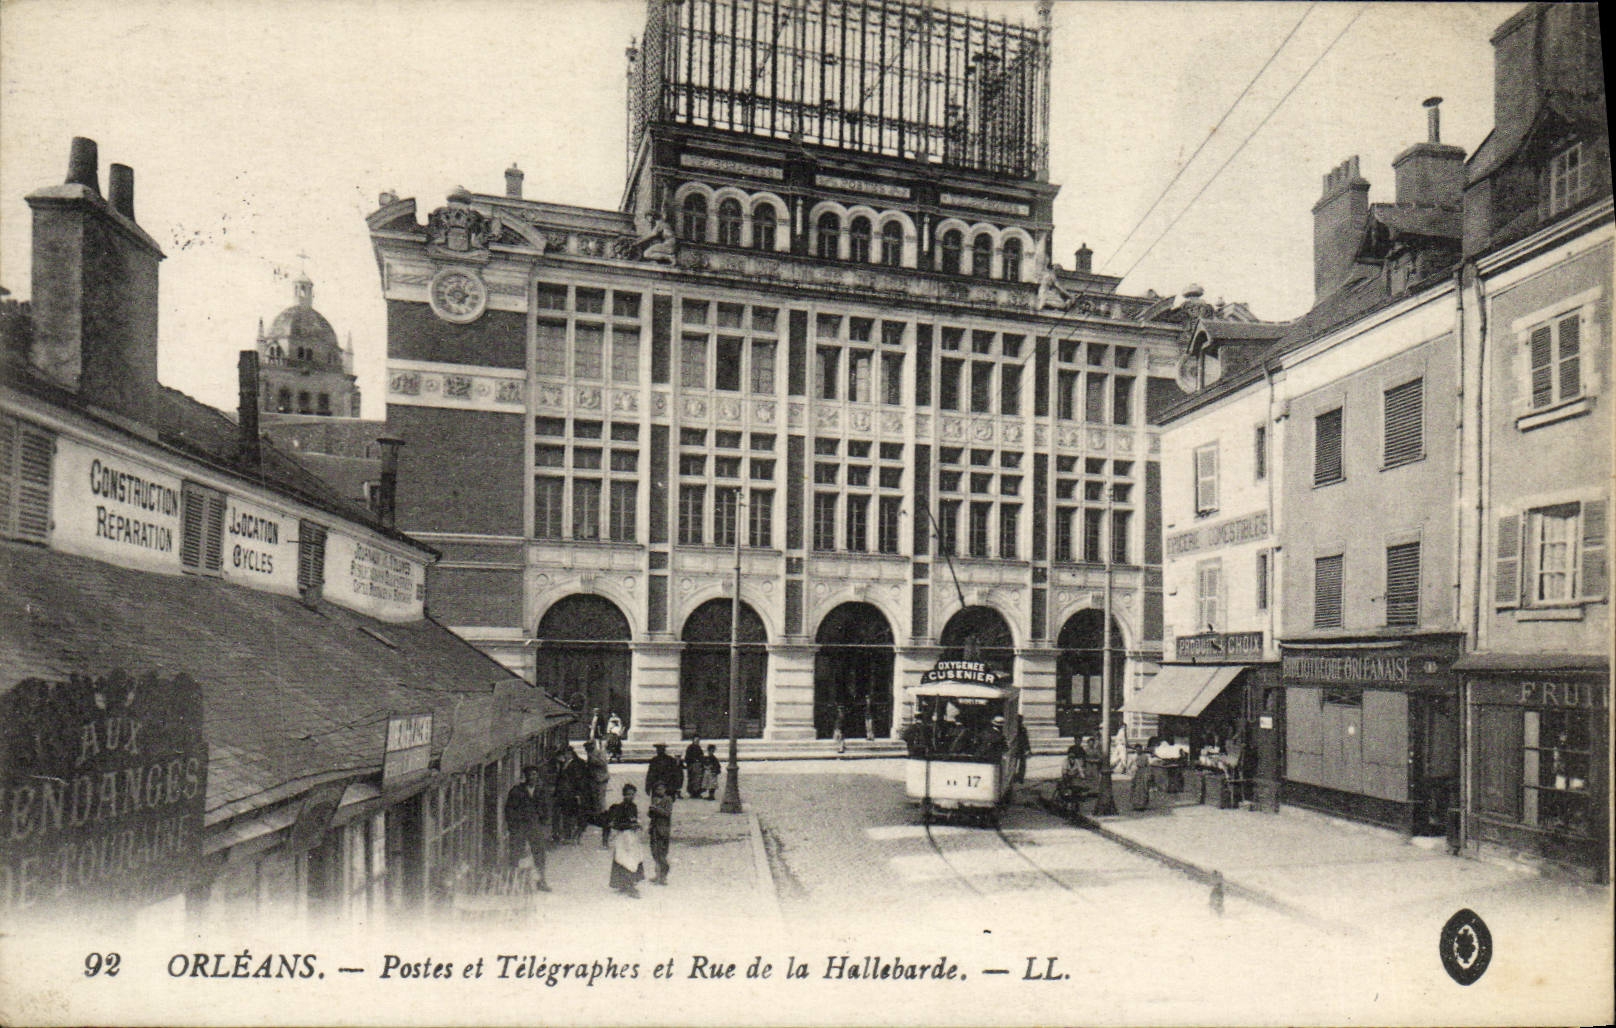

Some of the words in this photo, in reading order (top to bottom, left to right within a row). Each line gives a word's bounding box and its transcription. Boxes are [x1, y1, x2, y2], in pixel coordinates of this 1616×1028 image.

[1227, 635, 1260, 655] CHOIX
[928, 670, 995, 684] CUSENIER
[77, 717, 142, 764] AUX
[967, 775, 982, 788] 17
[0, 757, 199, 843] ENDANGES
